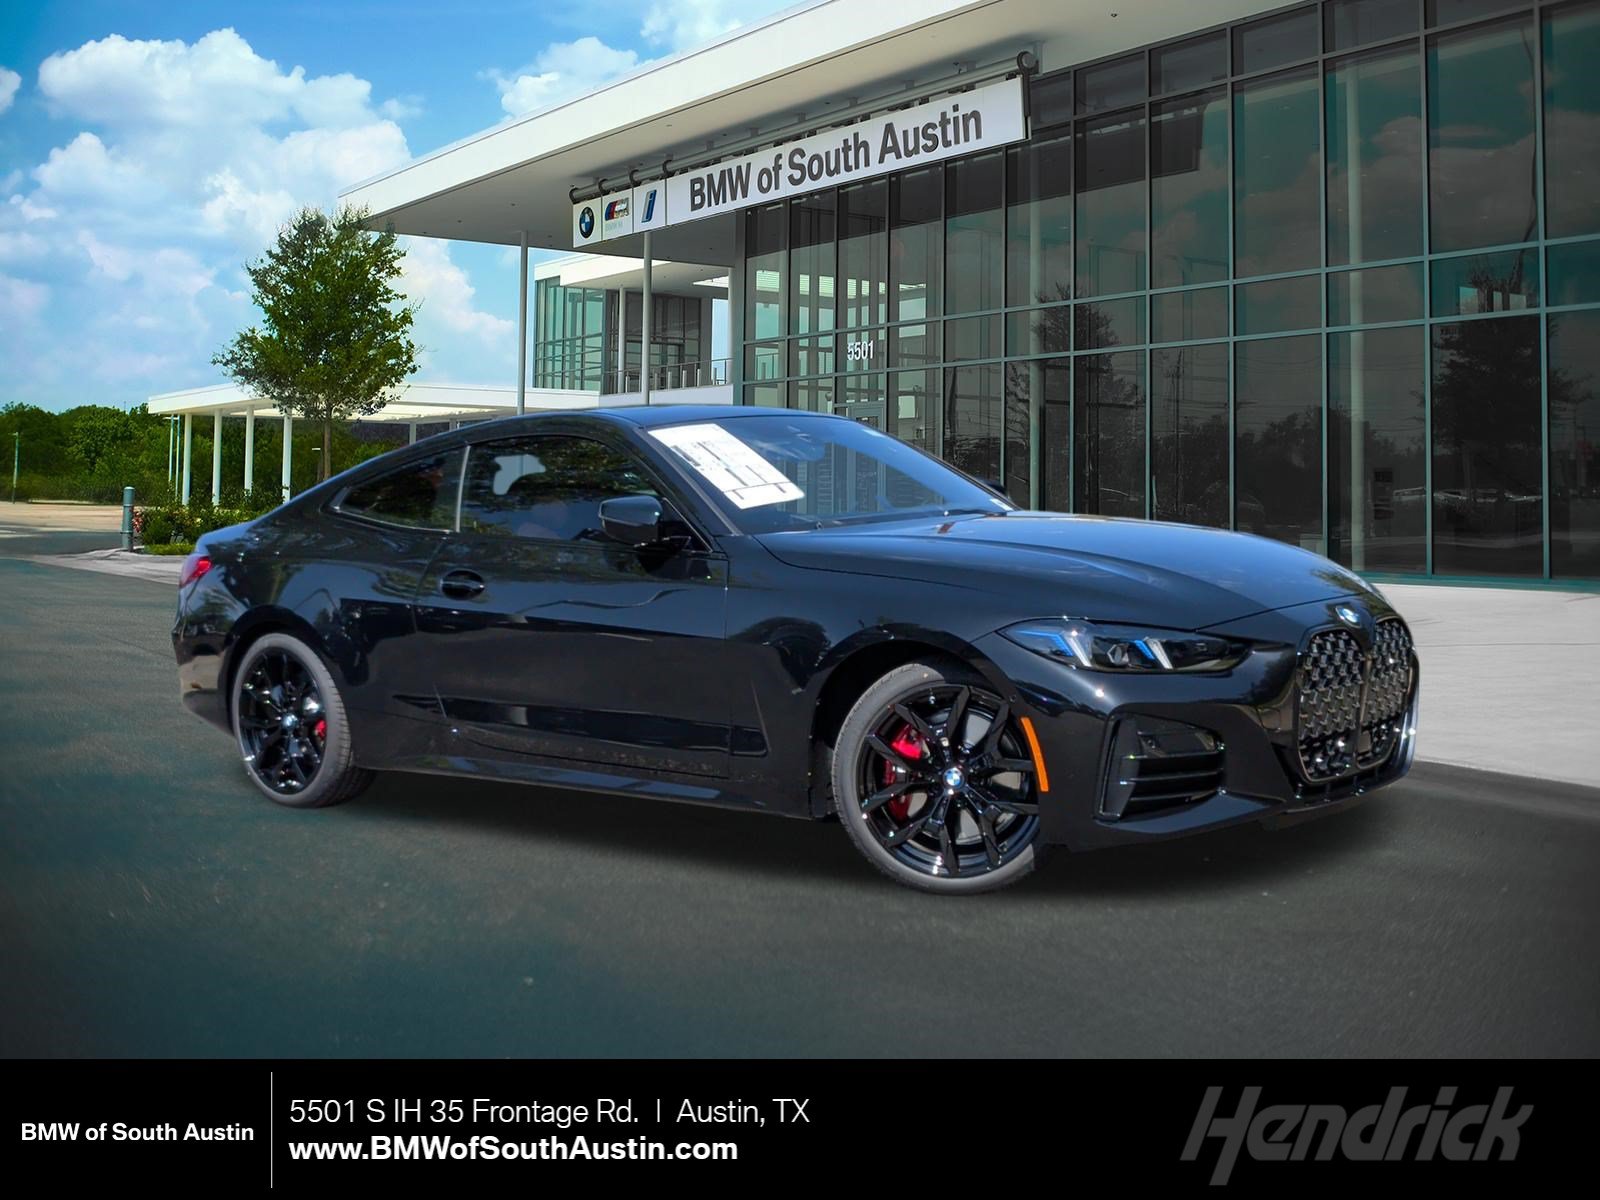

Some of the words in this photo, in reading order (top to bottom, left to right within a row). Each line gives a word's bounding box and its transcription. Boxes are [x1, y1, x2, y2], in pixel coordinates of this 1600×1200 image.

[690, 162, 751, 211] BMW
[757, 153, 783, 194] of
[787, 132, 870, 186] South
[878, 104, 982, 164] Austin
[847, 340, 874, 360] 5501
